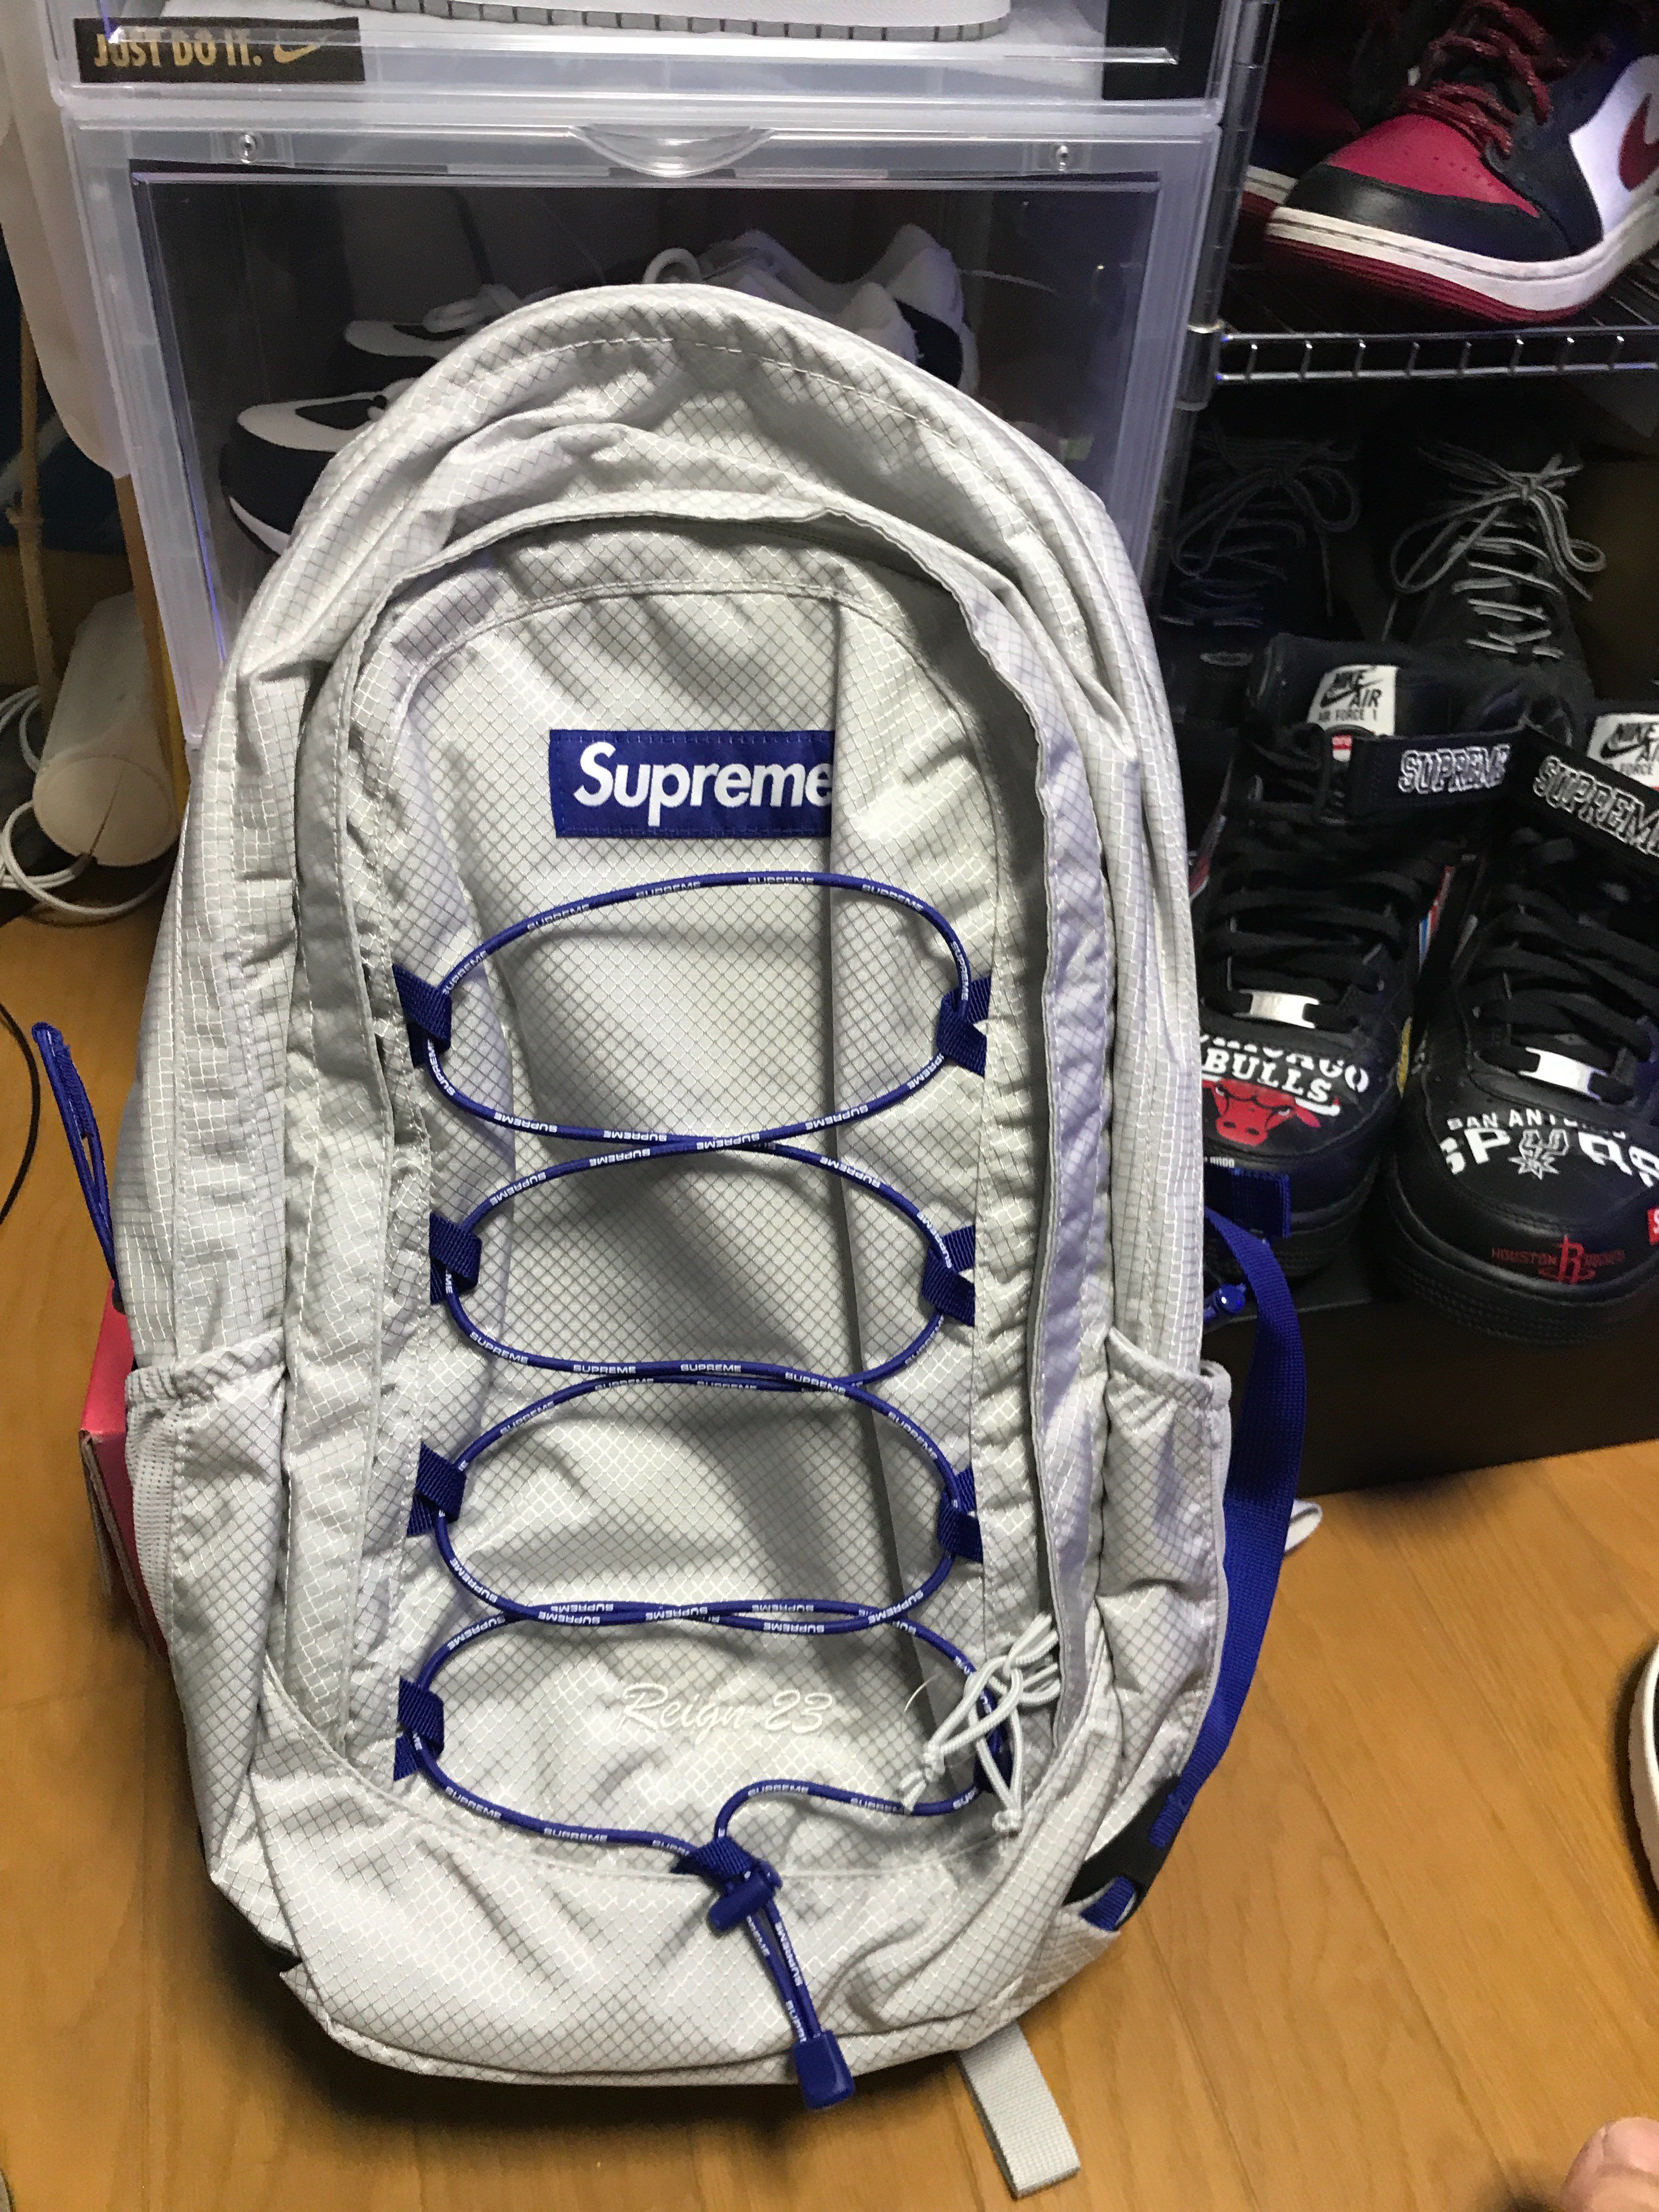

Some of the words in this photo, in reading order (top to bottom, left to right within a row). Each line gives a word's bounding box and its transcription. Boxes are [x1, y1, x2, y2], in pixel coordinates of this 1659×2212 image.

[94, 26, 161, 67] JUST
[171, 27, 217, 66] DO
[224, 27, 263, 66] IT.
[1348, 688, 1383, 708] AIR
[574, 741, 833, 827] Supreme
[1533, 755, 1659, 858] SUPREM
[907, 1053, 944, 1090] PREME
[1202, 1047, 1332, 1103] BULLS
[494, 1112, 558, 1133] SUPREME
[805, 1105, 868, 1130] SUPREME
[604, 1130, 667, 1142] SUPREME
[696, 1133, 760, 1150] SUPREME
[589, 1148, 651, 1167] SUPREME
[820, 1156, 881, 1188] SUPREME
[489, 1172, 546, 1206] SUPREME
[469, 1331, 529, 1365] SUPREME
[573, 1364, 636, 1374] SUPREME
[680, 1364, 741, 1372] SUPREME
[785, 1372, 846, 1394] SUPREME
[450, 1558, 499, 1603] SUPREME
[538, 1611, 600, 1625] SUPREME
[646, 1606, 708, 1621] SUPREME
[868, 1590, 923, 1624] SUPREME
[447, 1615, 505, 1650] SUPREME
[764, 1622, 824, 1633] SUPREME
[617, 1683, 747, 1744] Reign
[765, 1688, 833, 1734] 23
[775, 1921, 803, 1986] SUPREME
